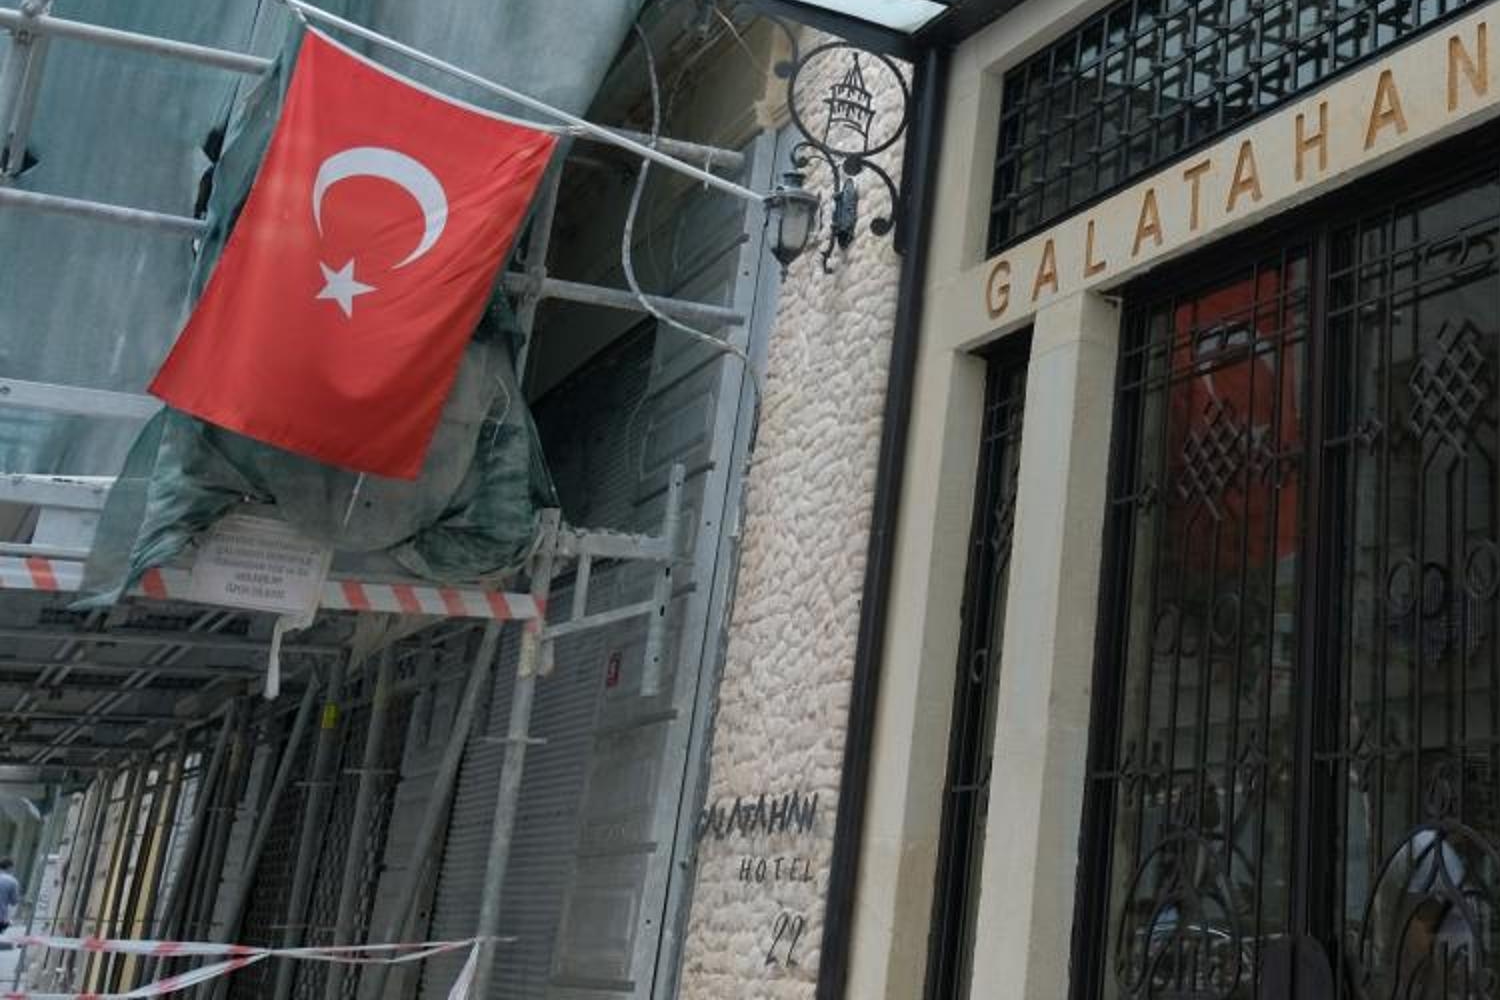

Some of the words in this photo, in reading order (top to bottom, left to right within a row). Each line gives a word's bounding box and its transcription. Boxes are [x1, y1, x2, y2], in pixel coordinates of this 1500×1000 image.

[985, 20, 1488, 319] GALATAHAN
[698, 789, 818, 841] ALATAHAN
[738, 856, 815, 883] HOTEL
